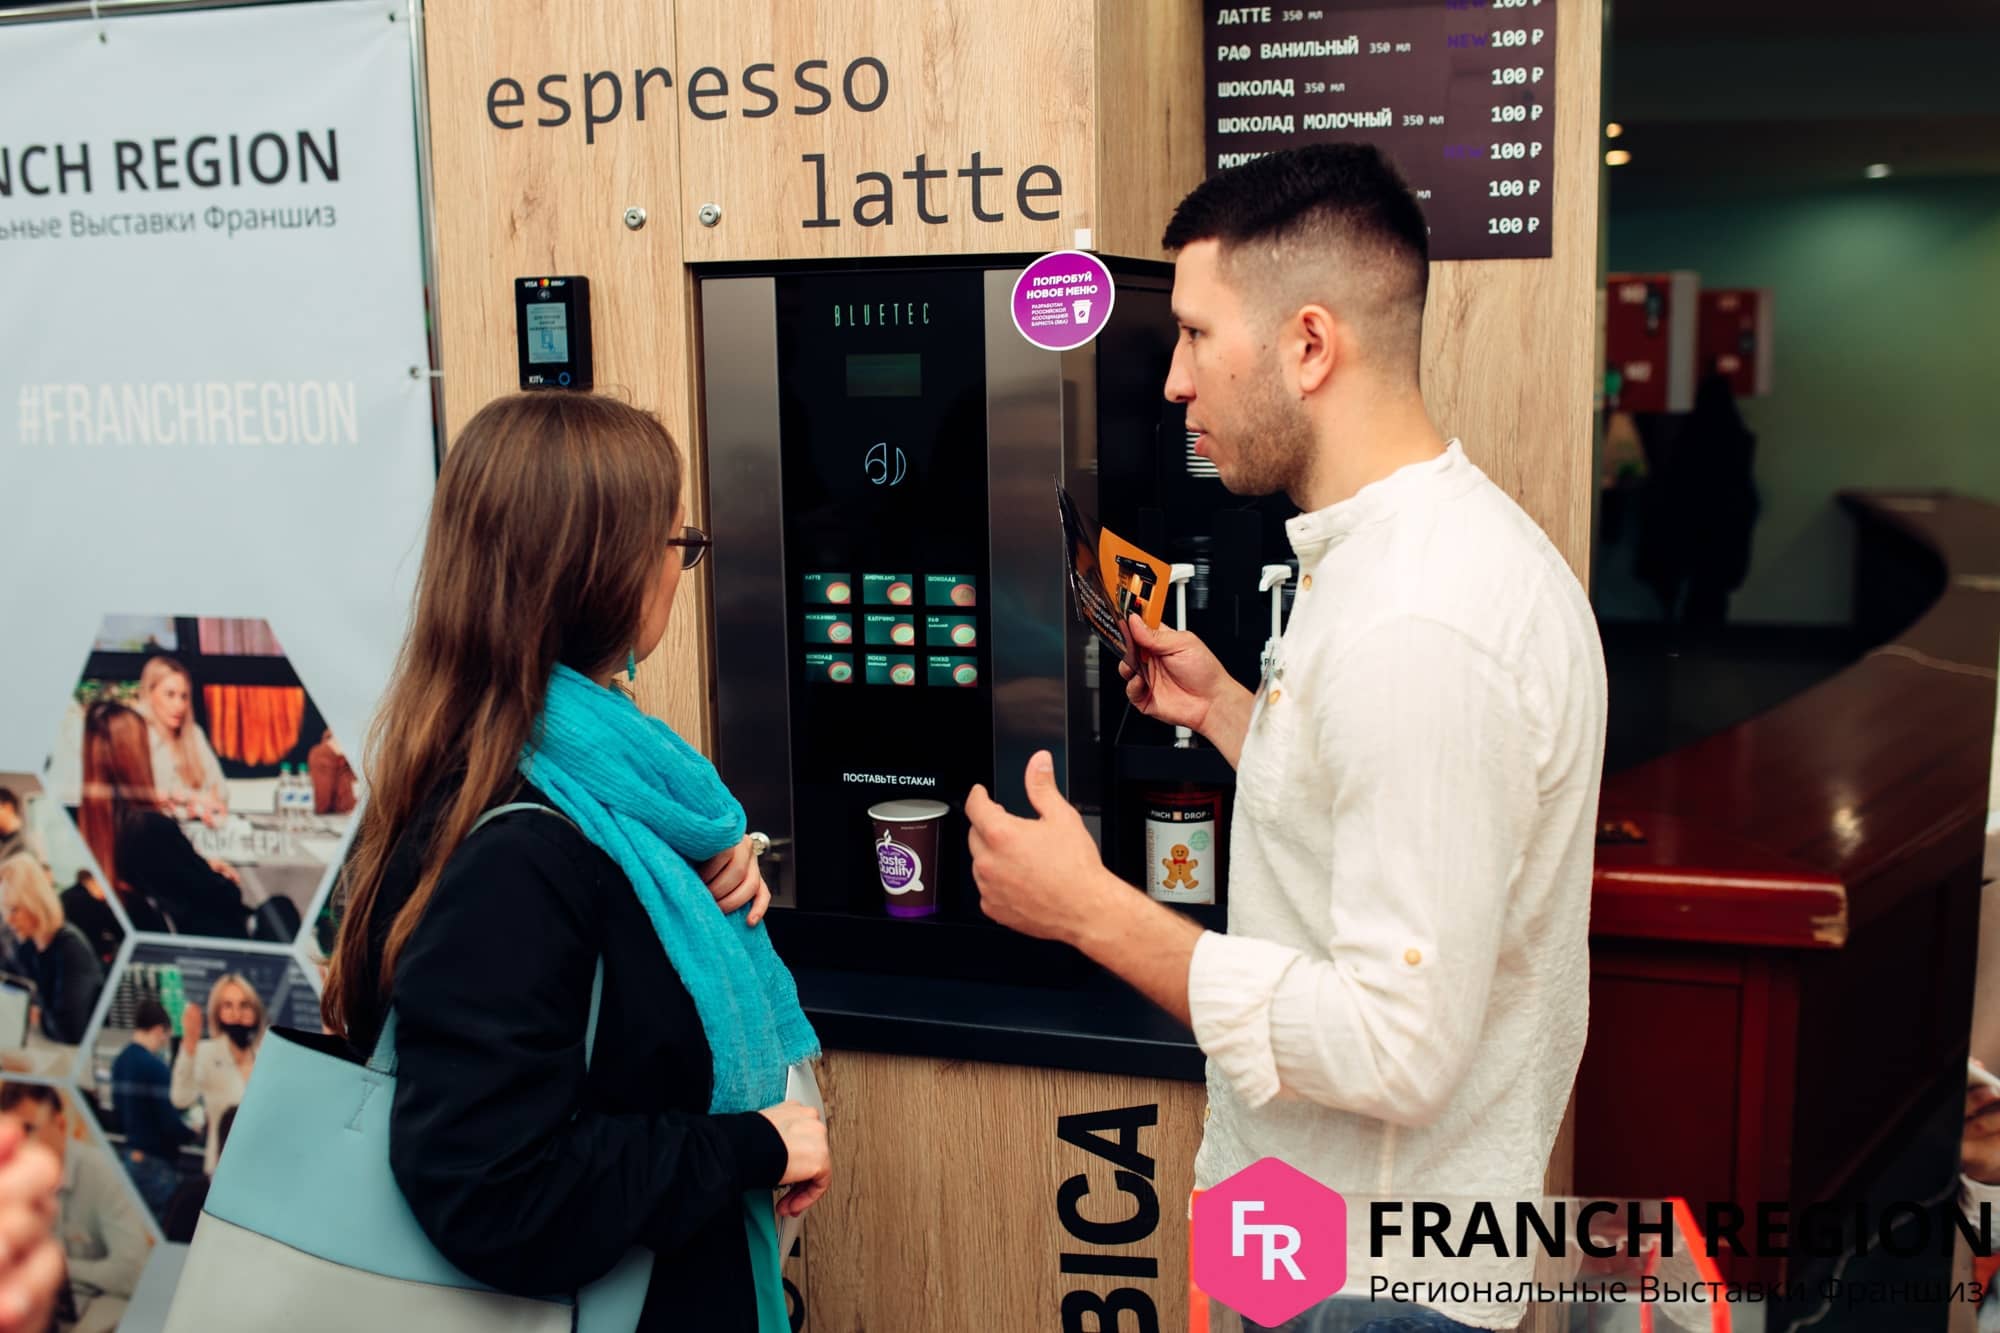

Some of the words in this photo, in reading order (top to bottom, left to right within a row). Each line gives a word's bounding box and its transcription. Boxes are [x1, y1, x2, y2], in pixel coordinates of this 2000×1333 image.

[1217, 7, 1271, 25] ЛАТТЕ
[1282, 10, 1303, 22] 350
[1308, 10, 1323, 20] мл
[1491, 29, 1527, 47] 100
[1217, 45, 1251, 61] РАФ
[1260, 35, 1359, 59] ВАНИЛЬНЫЙ
[1369, 42, 1390, 54] 350
[1395, 42, 1411, 52] мл
[1491, 67, 1527, 85] 100
[1217, 78, 1295, 97] ШОКОЛАД
[1304, 82, 1325, 94] 350
[1330, 83, 1345, 92] мл
[486, 56, 889, 145] espresso
[1217, 115, 1295, 133] ШОКОЛАД
[1303, 107, 1392, 129] МОЛОЧНЫЙ
[1402, 115, 1424, 126] 350
[1429, 115, 1444, 125] мл
[1491, 105, 1526, 122] 100
[1490, 142, 1525, 159] 100
[114, 129, 340, 191] REGION
[802, 151, 1063, 229] latte
[1416, 190, 1432, 200] мл
[1489, 180, 1524, 197] 100
[69, 210, 196, 238] Выставки
[203, 205, 337, 238] Франшиз
[1488, 217, 1523, 234] 100
[1033, 271, 1092, 286] ПОПРОБУЙ
[1026, 287, 1064, 300] НОВОЕ
[1066, 285, 1098, 298] МЕНЮ
[834, 302, 930, 327] BLUETEC
[18, 380, 359, 446] #FRANCHREGION
[843, 773, 897, 784] ПОСТАВЬТЕ
[898, 776, 936, 786] СТАКАН
